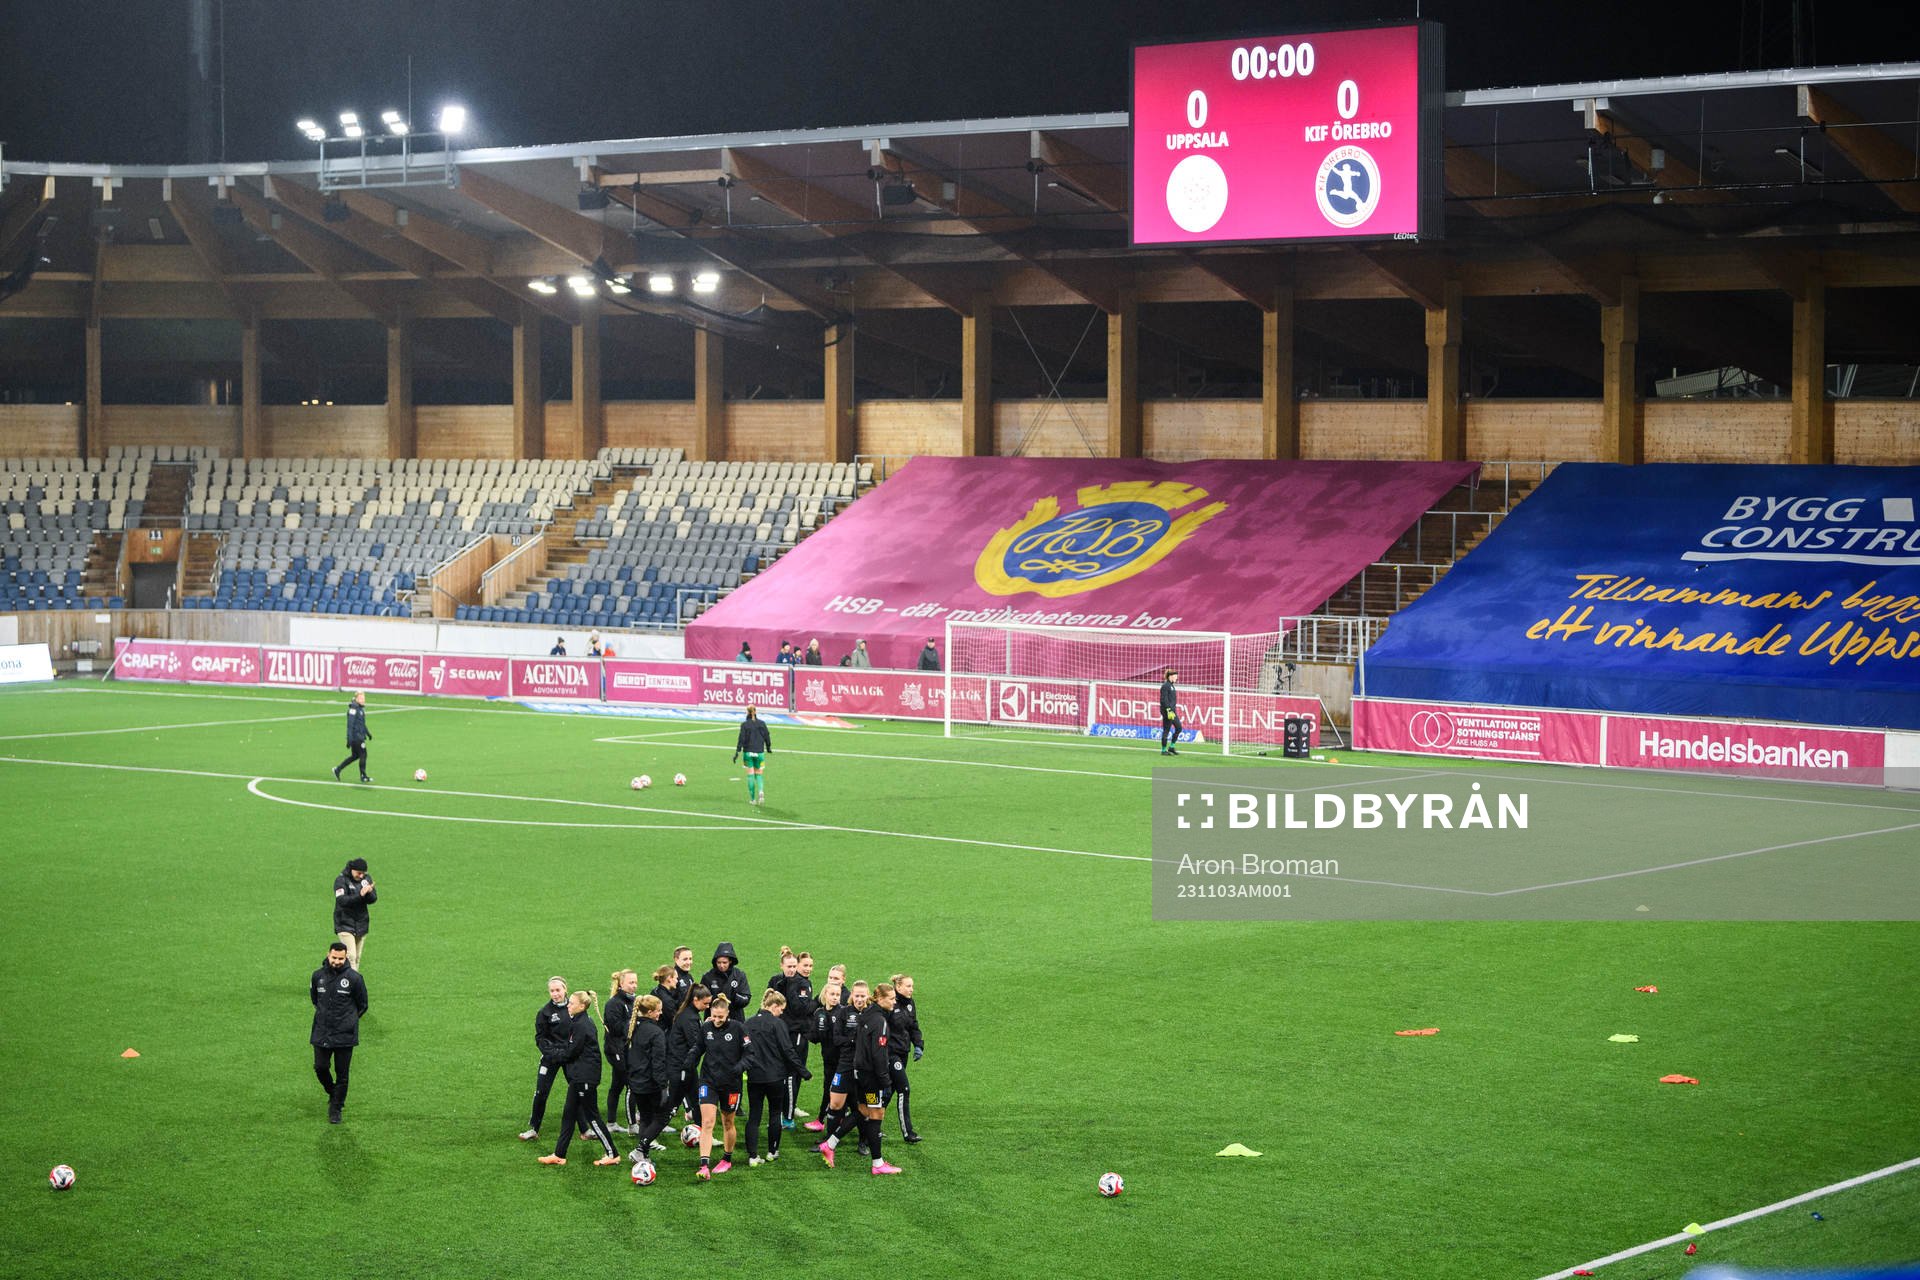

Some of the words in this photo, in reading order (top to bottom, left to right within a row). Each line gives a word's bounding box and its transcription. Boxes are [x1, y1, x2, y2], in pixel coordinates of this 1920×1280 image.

[1231, 42, 1315, 81] 00:00
[1186, 89, 1208, 129] 0
[1337, 80, 1359, 119] 0
[1166, 131, 1230, 150] UPPSALA
[1305, 125, 1328, 142] KIF
[1331, 121, 1392, 141] ÖREBRO
[1722, 496, 1866, 522] BYGG
[150, 530, 162, 540] 11
[512, 535, 521, 546] 10
[1013, 517, 1163, 557] HSB
[1568, 574, 1833, 609] Tillsammans
[824, 595, 884, 615] HSB
[900, 602, 949, 620] där
[1130, 612, 1184, 630] bor
[1525, 605, 1594, 641] ett
[1594, 618, 1792, 656] vinnande
[121, 652, 168, 669] CRAFT
[191, 655, 241, 672] CRAFT
[268, 651, 335, 685] ZELLOUT
[449, 668, 502, 681] SEGWAY
[523, 664, 589, 686] AGENDA
[703, 689, 733, 703] svets
[735, 688, 745, 704] &
[746, 689, 784, 706] smide
[868, 686, 885, 697] GK
[1046, 691, 1077, 701] Electrolux
[1030, 690, 1079, 716] Home
[1110, 728, 1137, 738] OBOS
[1456, 718, 1518, 730] VENTILATION
[1519, 721, 1540, 731] OCH
[1456, 728, 1541, 741] SOTNINGSTJÄNST
[1494, 740, 1503, 748] AB
[1640, 730, 1849, 769] Handelsbanken
